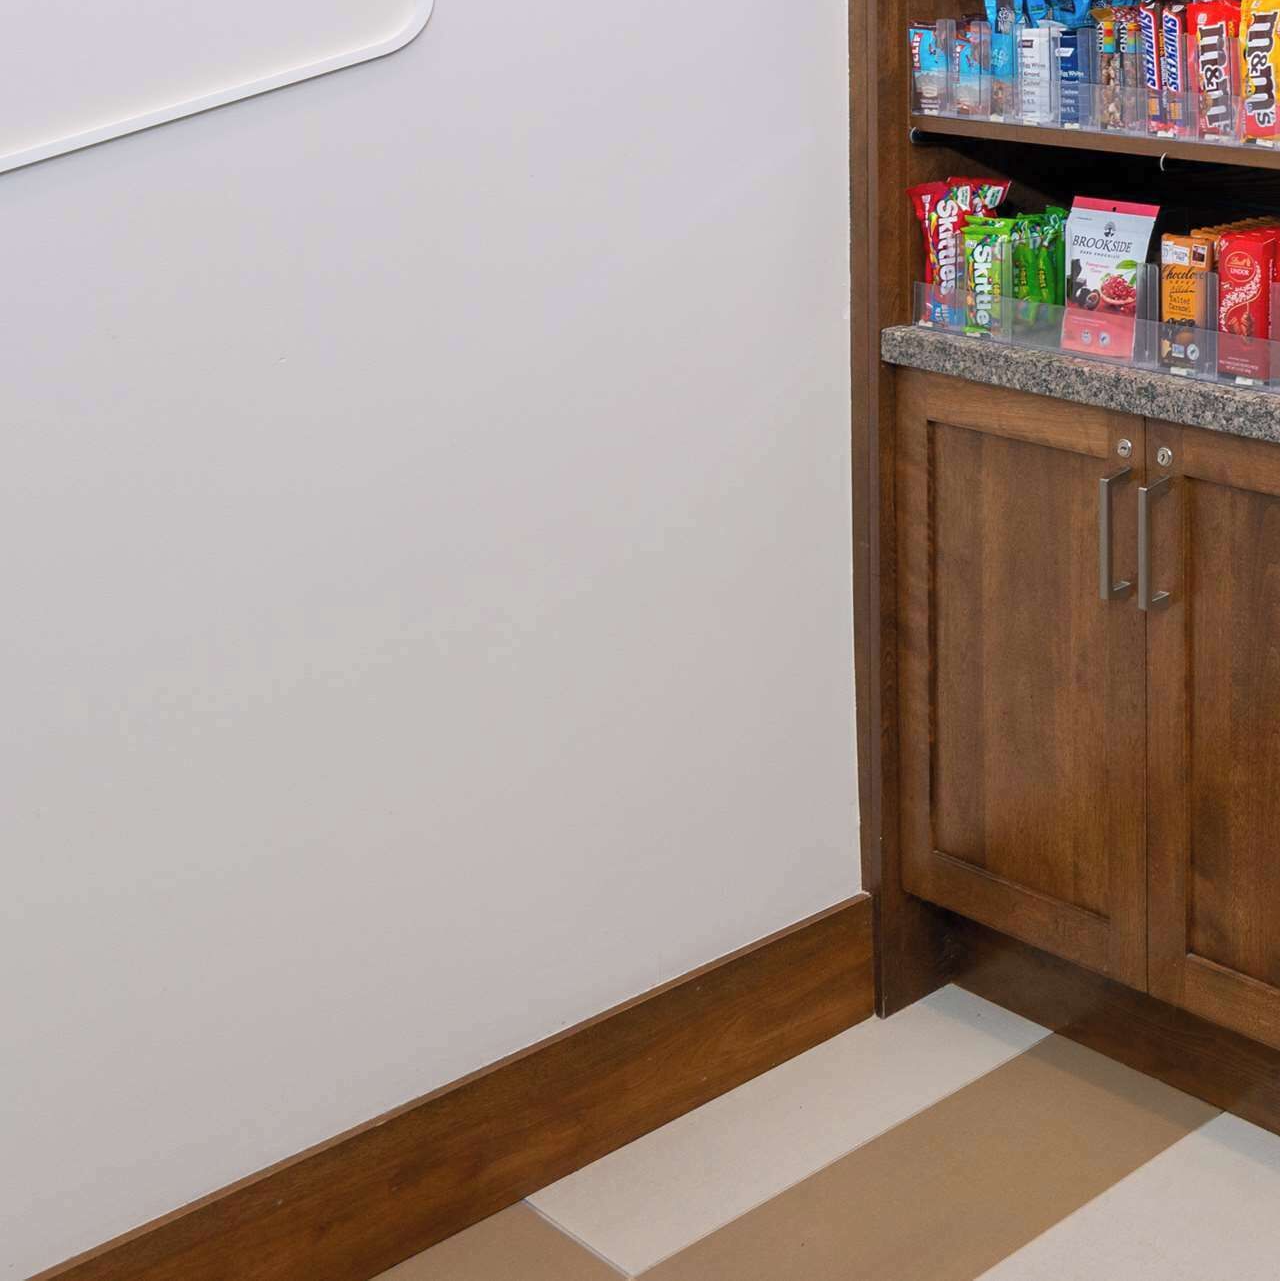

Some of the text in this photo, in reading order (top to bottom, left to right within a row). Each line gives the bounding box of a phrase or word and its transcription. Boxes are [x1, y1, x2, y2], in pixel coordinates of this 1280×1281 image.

[1139, 9, 1157, 90] SNICKERS
[1163, 15, 1179, 92] SNICKERS
[937, 199, 958, 296] Skittles
[1072, 233, 1133, 254] BROOKSIDE
